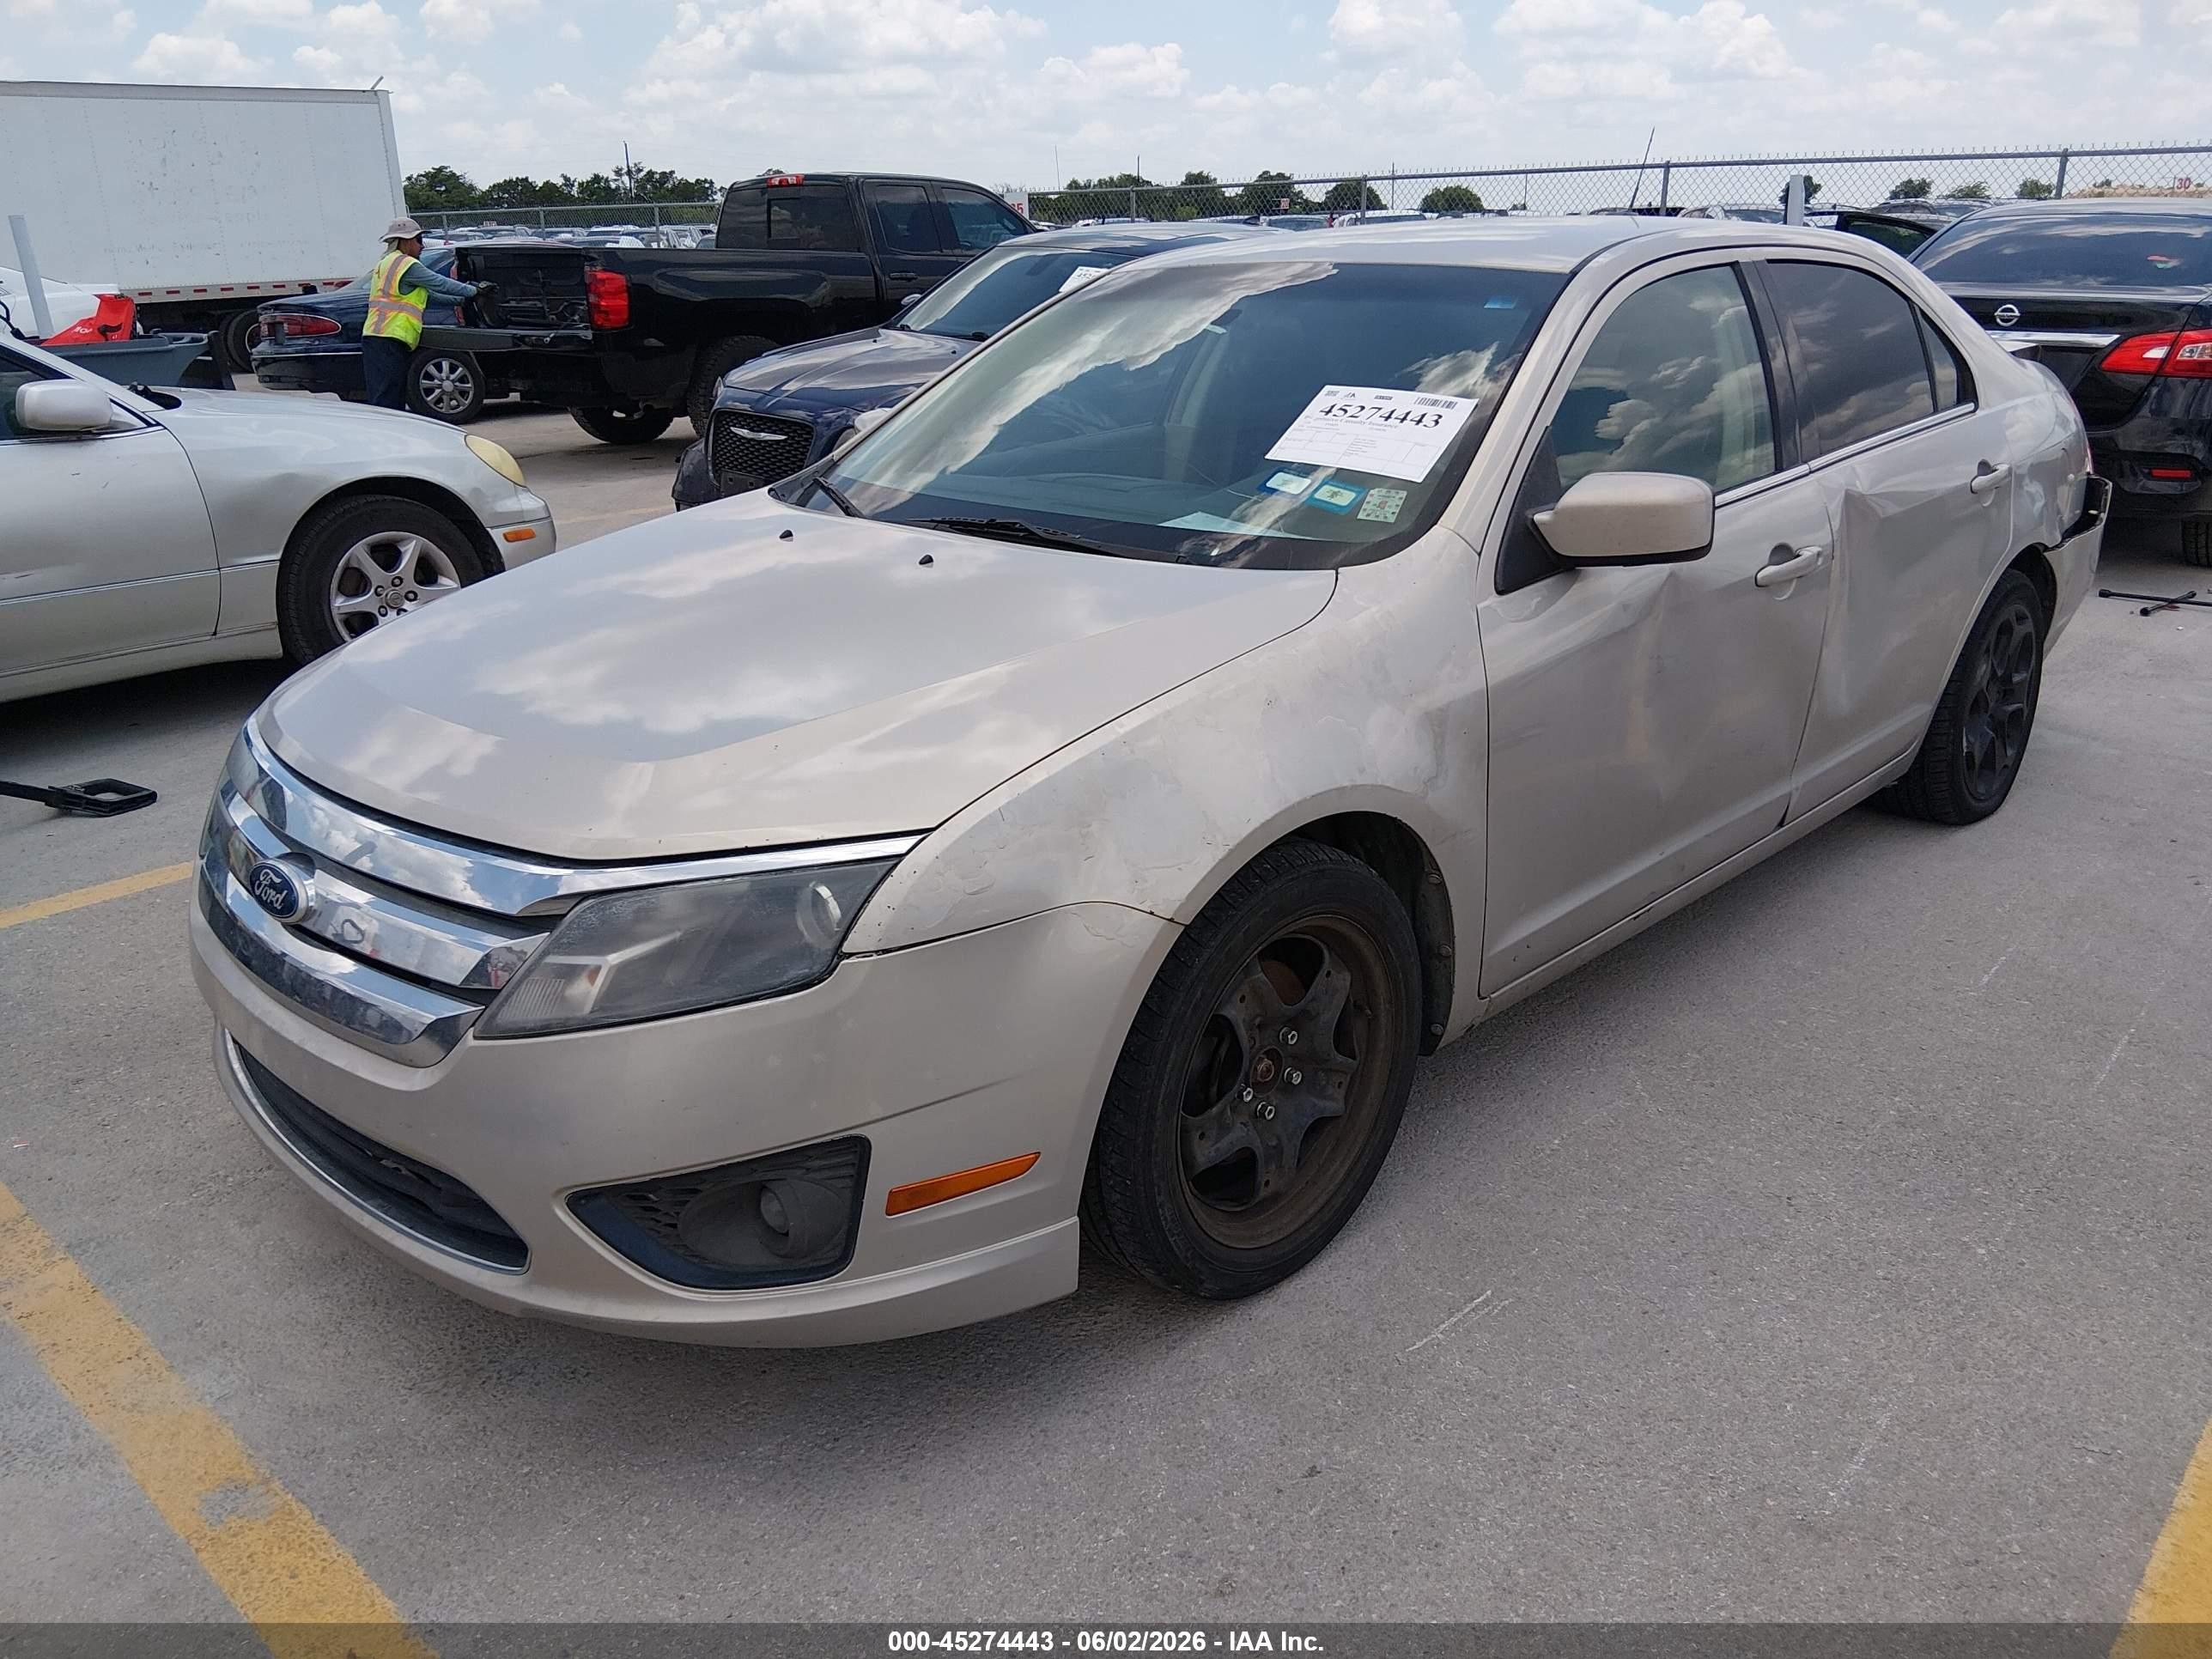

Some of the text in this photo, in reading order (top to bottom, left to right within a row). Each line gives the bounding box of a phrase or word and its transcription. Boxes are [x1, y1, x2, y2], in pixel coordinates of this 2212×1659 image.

[2176, 177, 2191, 190] 30
[1319, 403, 1443, 428] 45274443
[254, 868, 288, 910] Ford
